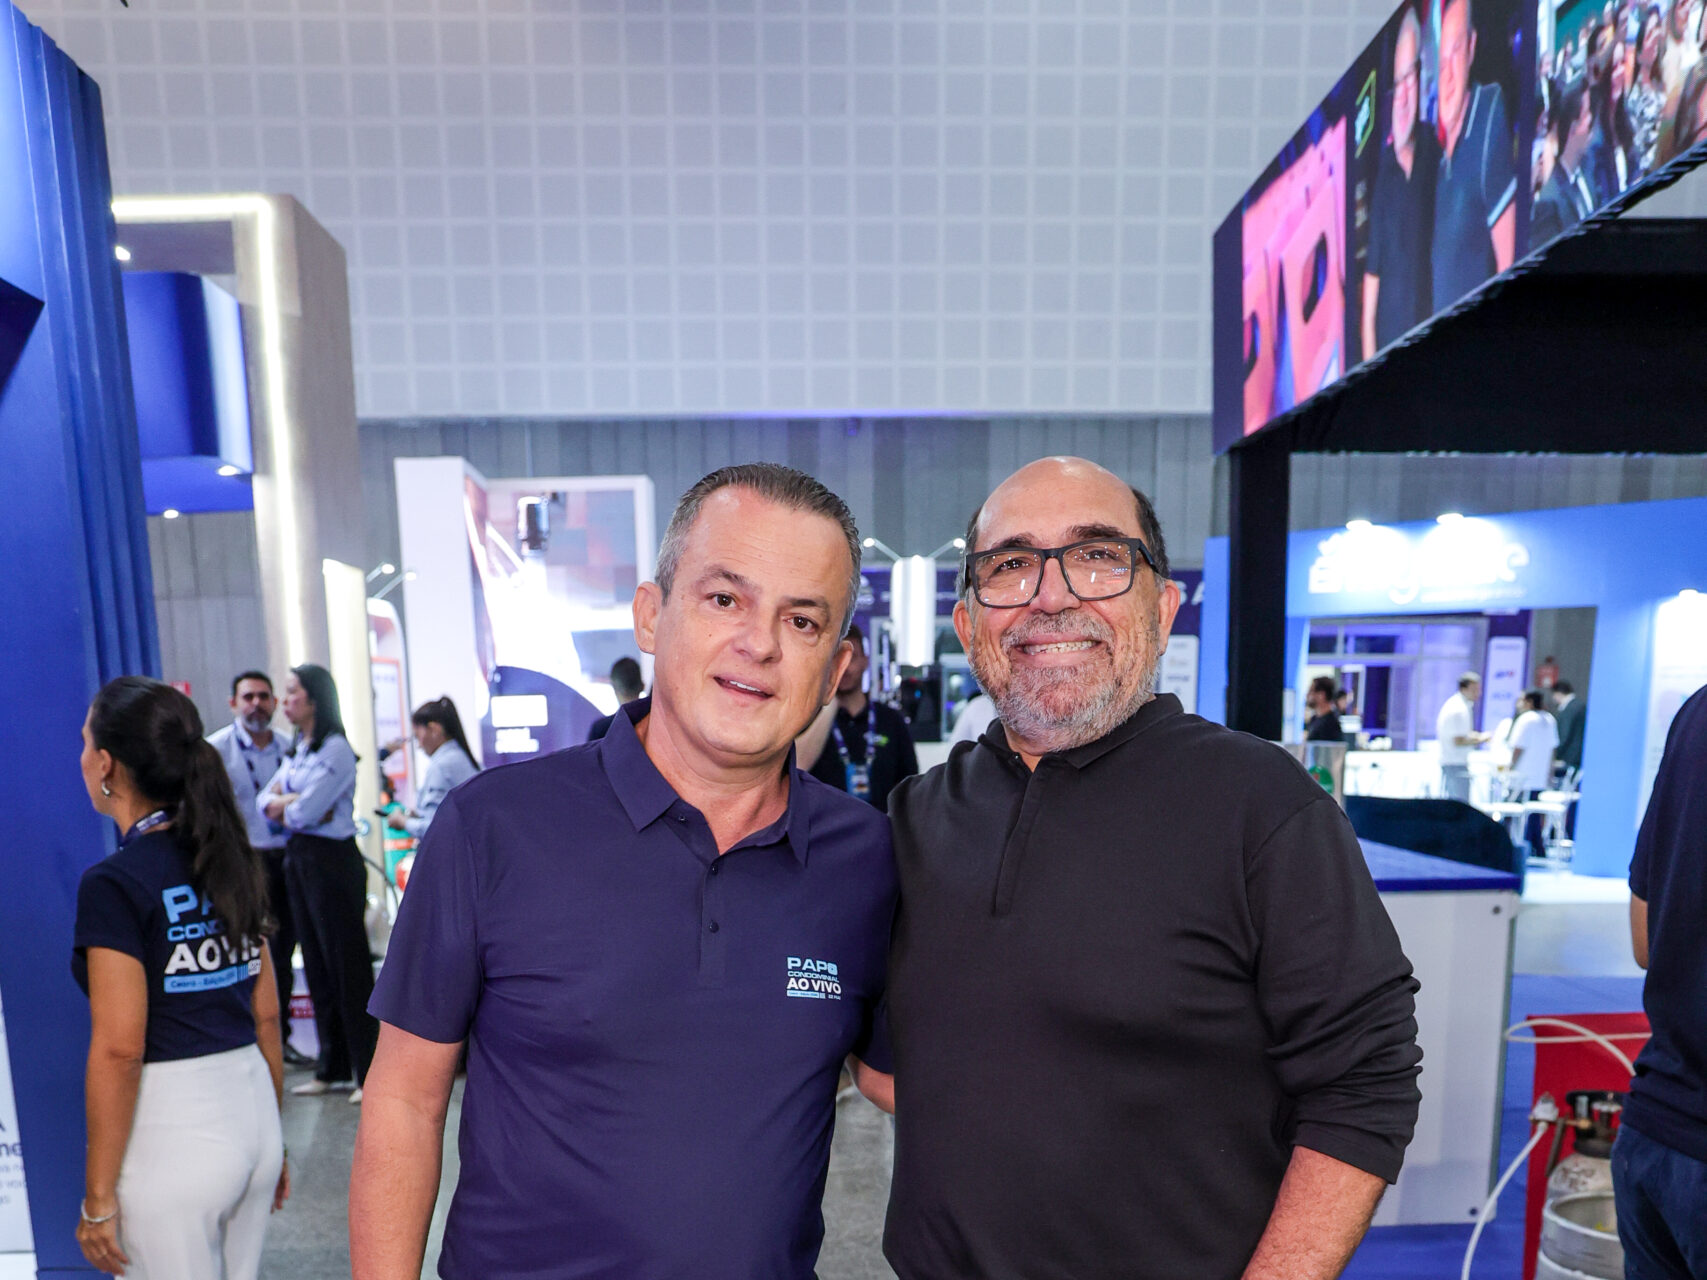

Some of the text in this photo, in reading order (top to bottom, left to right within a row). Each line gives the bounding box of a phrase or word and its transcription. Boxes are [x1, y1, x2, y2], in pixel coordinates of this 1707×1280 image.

[164, 938, 220, 975] AO
[786, 977, 841, 994] AO VIVO
